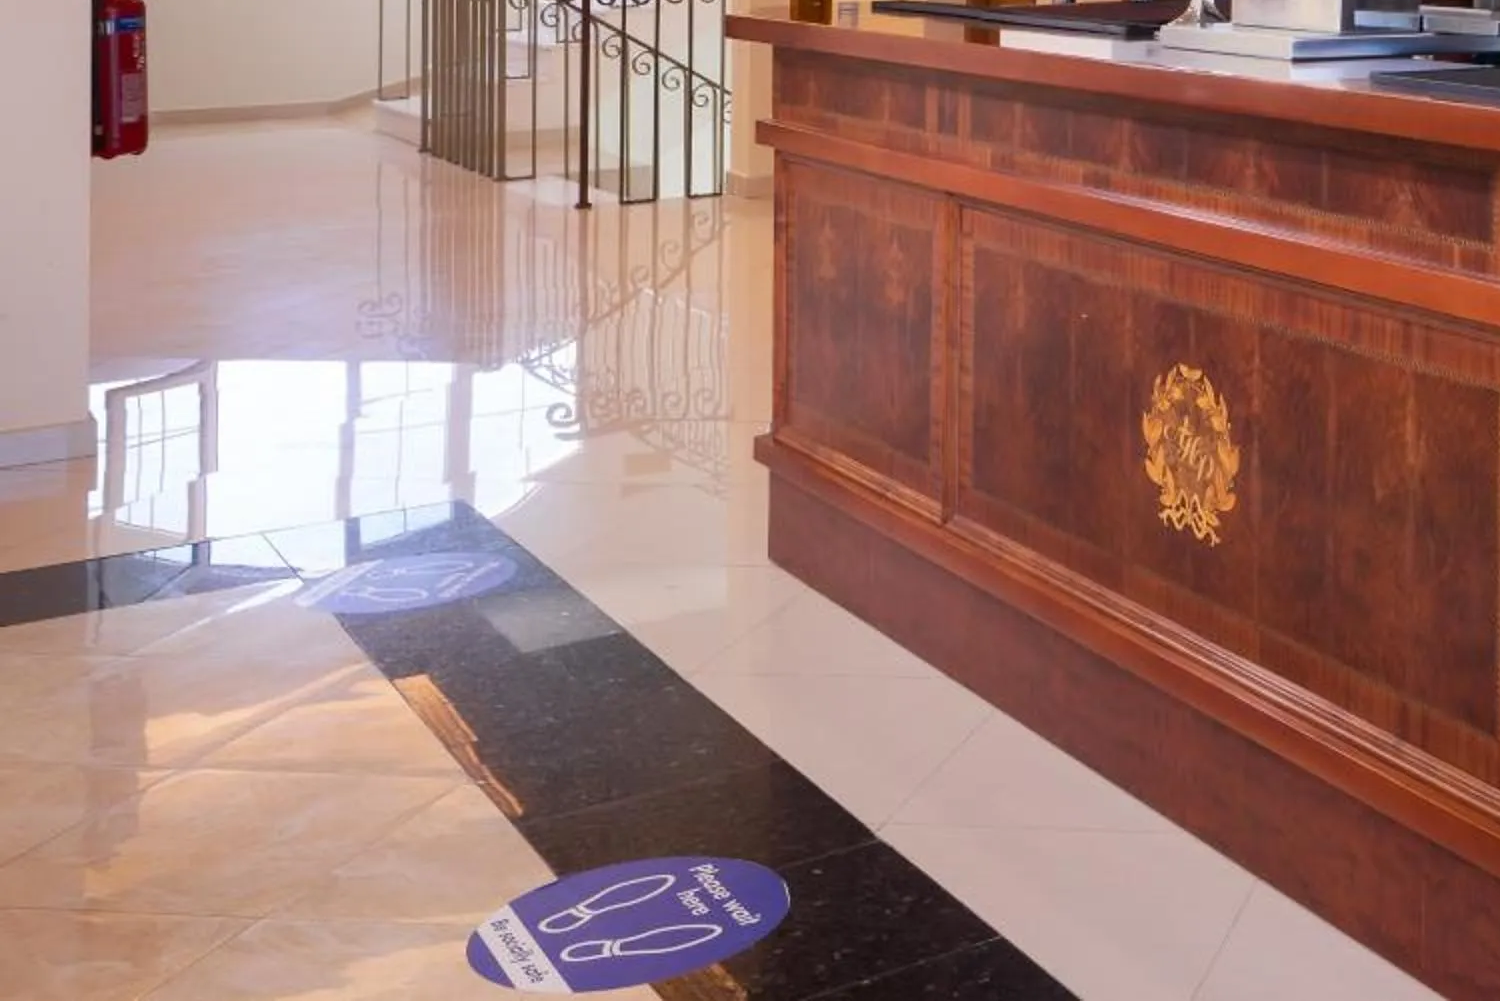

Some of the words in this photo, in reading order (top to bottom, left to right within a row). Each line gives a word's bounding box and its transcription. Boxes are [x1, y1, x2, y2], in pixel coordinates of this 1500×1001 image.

[676, 887, 711, 916] here
[688, 864, 731, 899] Please
[722, 899, 761, 926] wait
